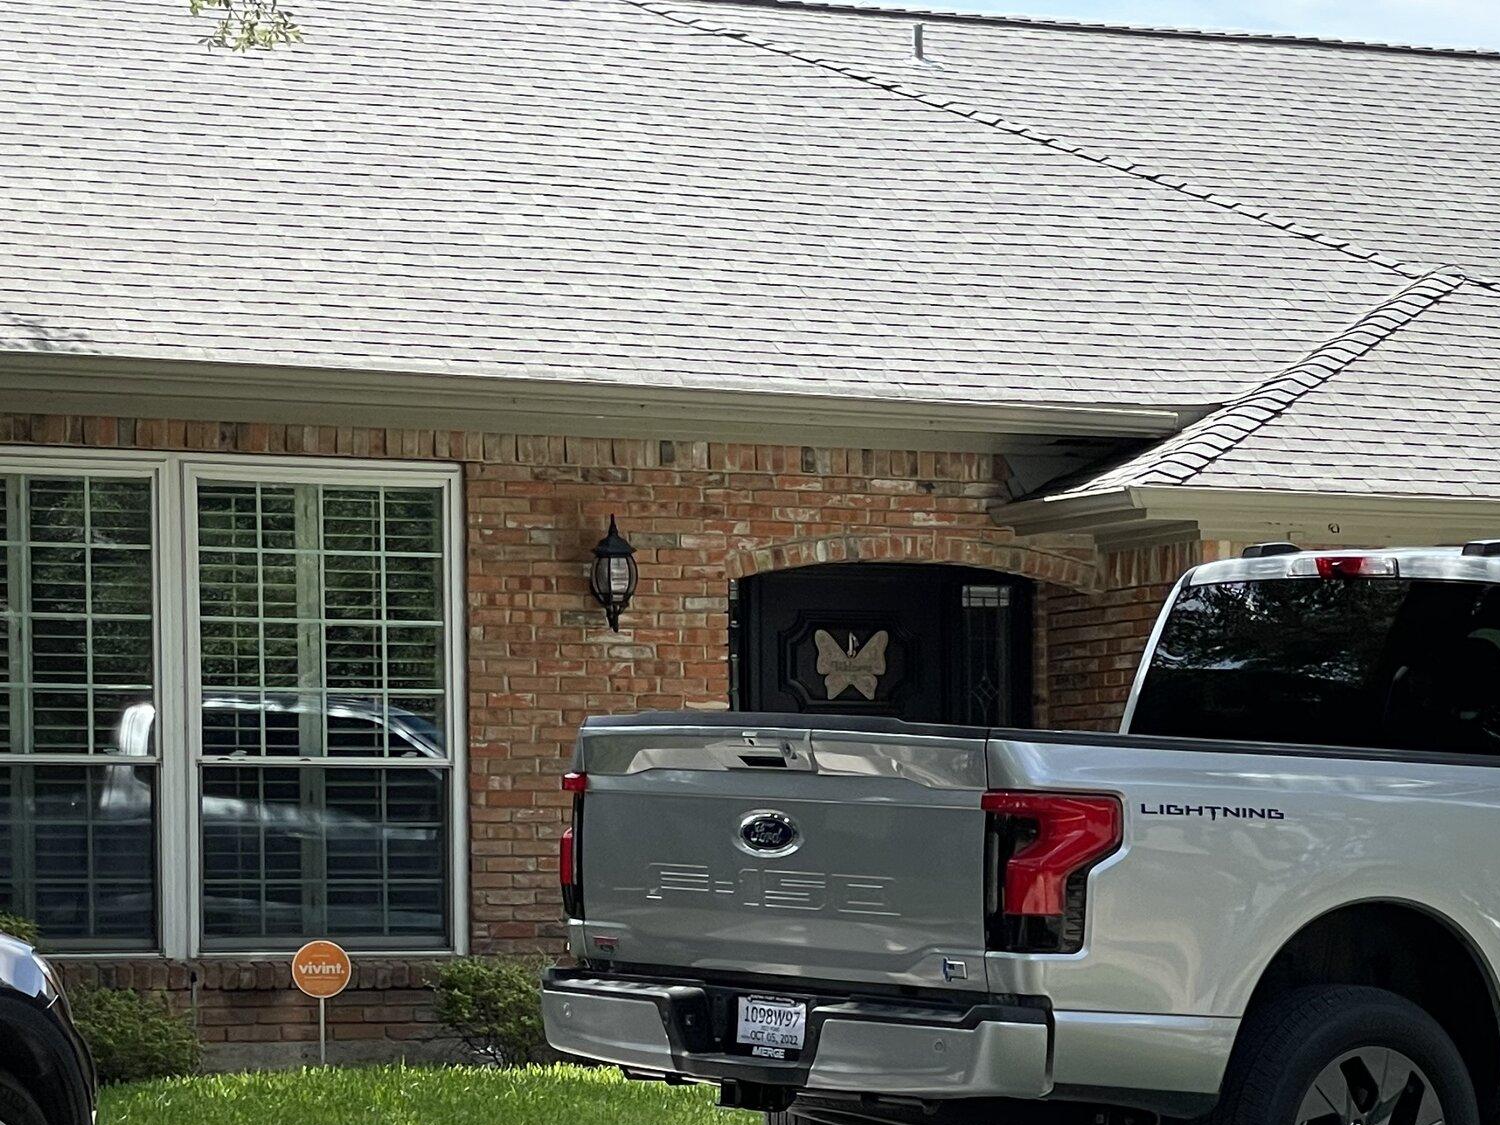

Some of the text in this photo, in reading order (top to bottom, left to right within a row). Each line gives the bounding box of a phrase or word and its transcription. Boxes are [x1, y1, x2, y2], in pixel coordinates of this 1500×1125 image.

[1140, 803, 1285, 821] LIGHTNING
[744, 1005, 801, 1029] 1098W97
[750, 1029, 765, 1042] OCT
[780, 1034, 799, 1045] 2022
